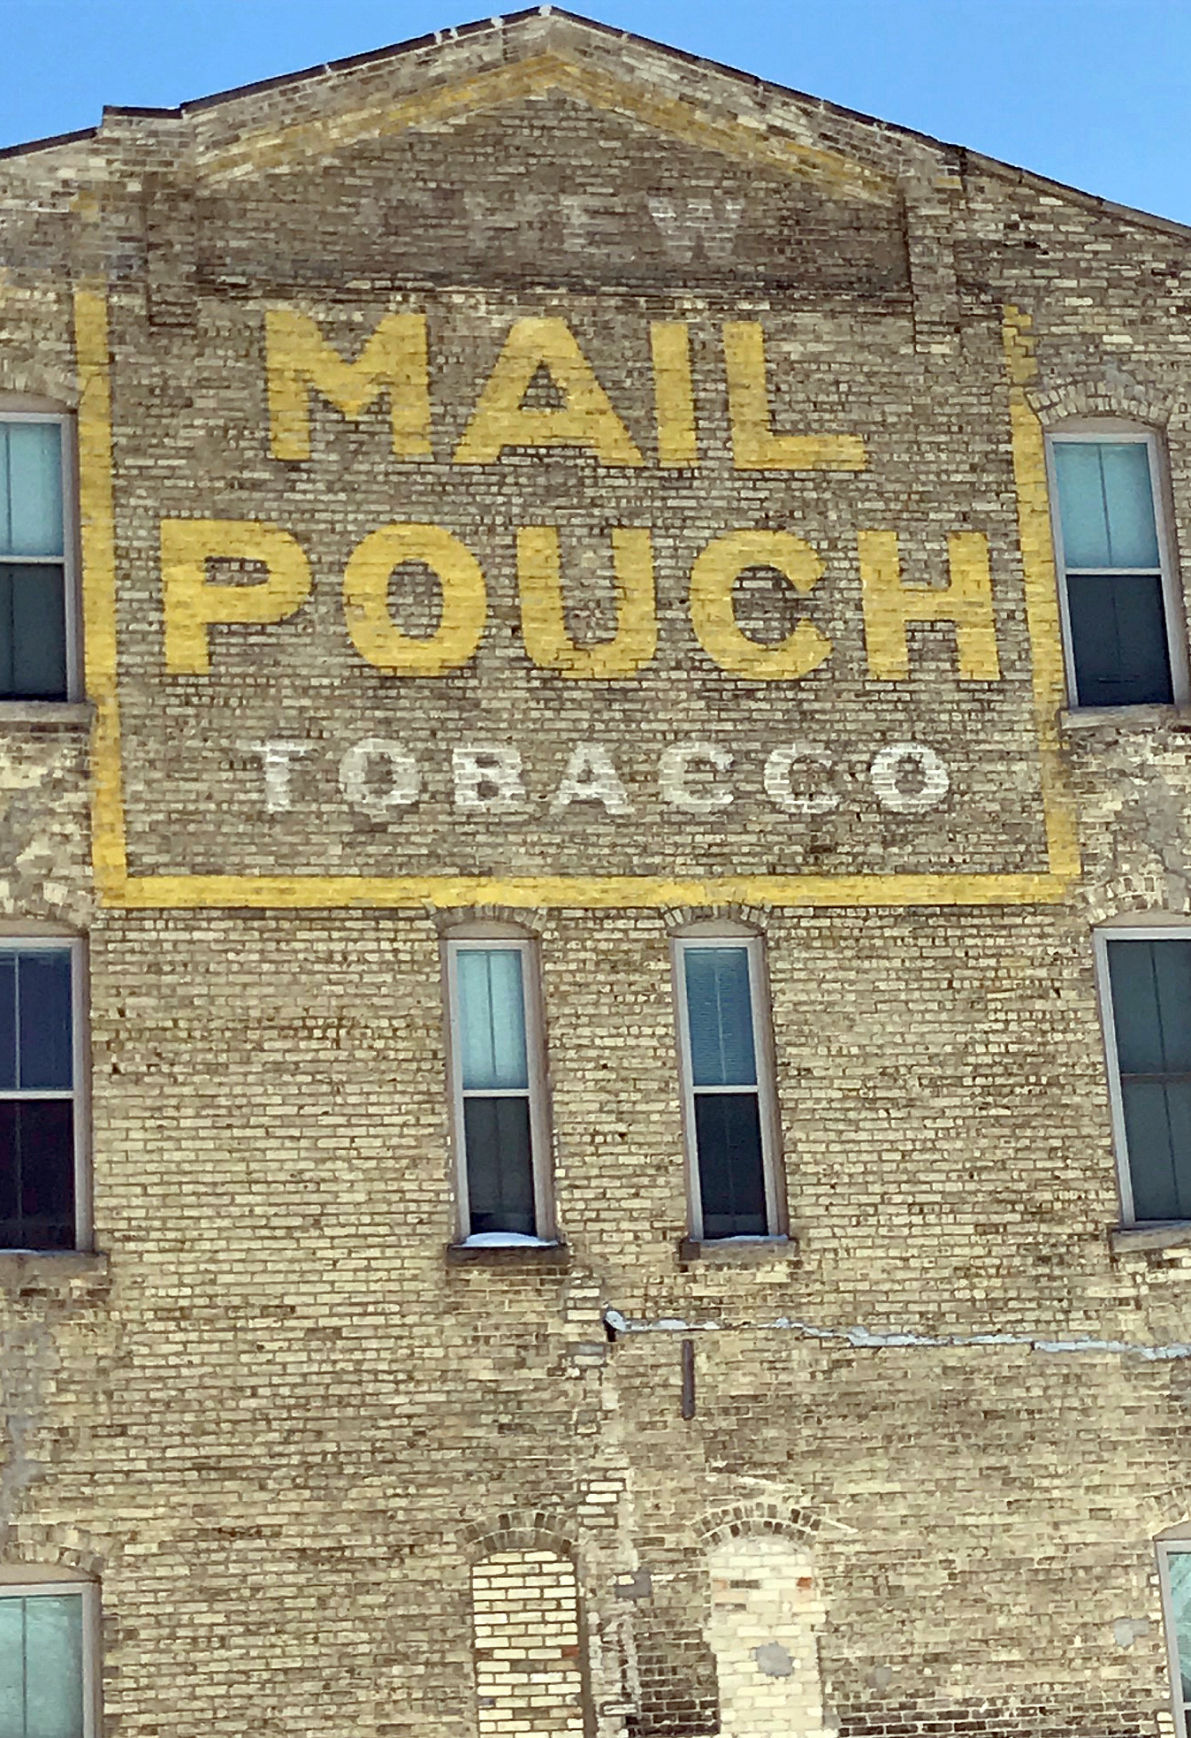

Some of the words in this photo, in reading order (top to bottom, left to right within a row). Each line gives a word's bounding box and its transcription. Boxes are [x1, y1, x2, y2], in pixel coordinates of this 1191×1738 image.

[264, 310, 868, 472] MAIL
[159, 517, 1001, 683] POUCH
[249, 737, 951, 817] TOBACCO
